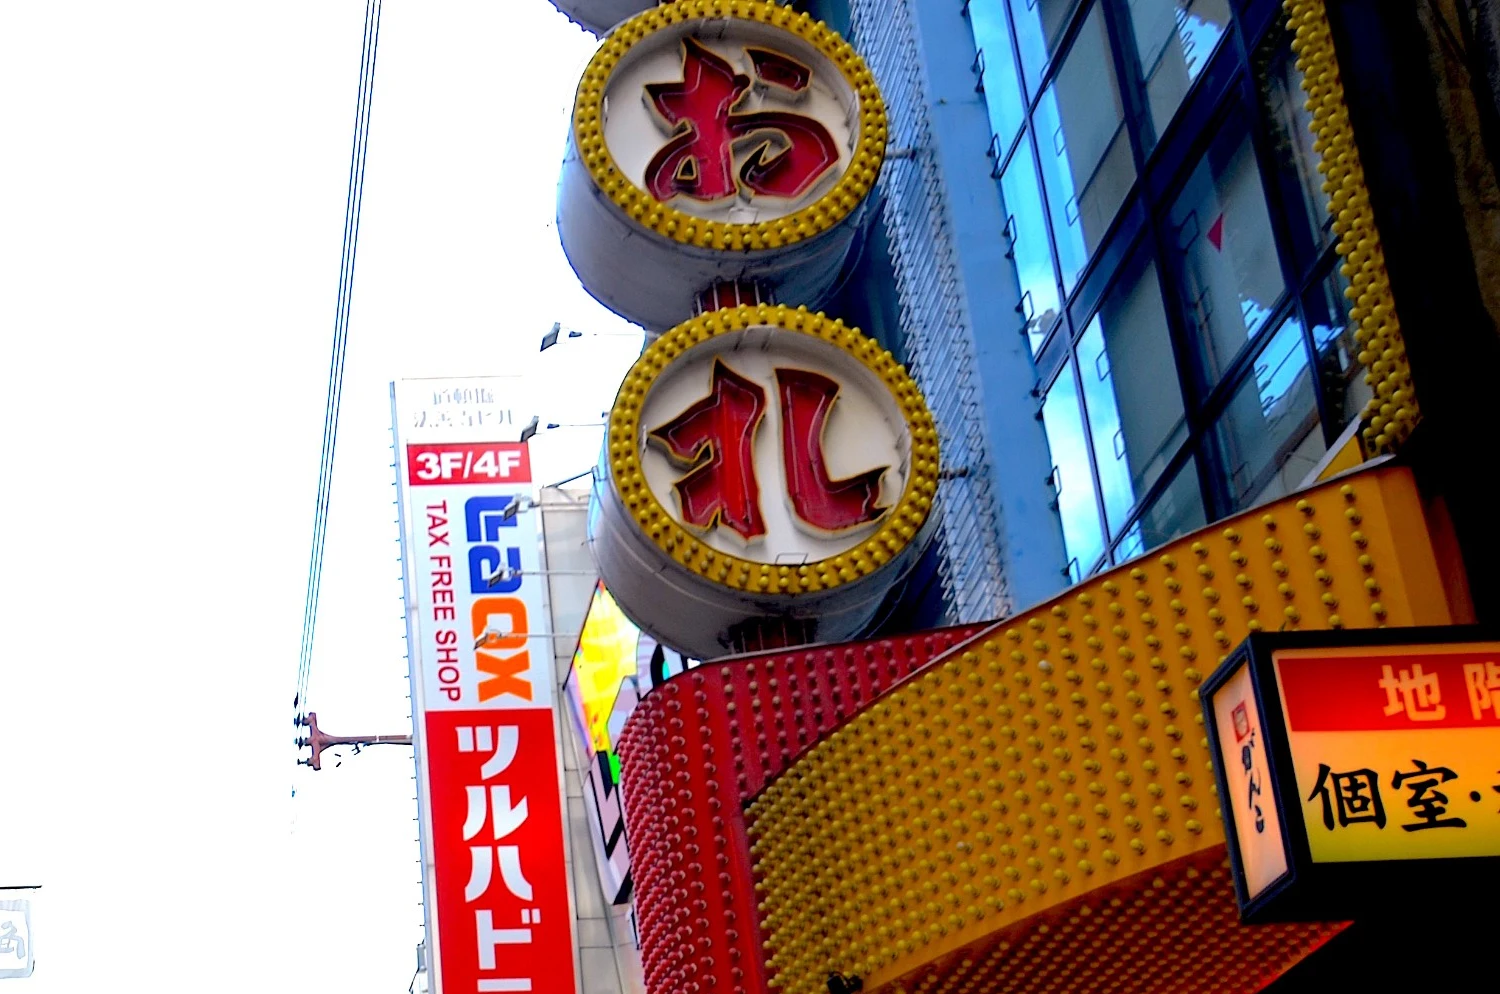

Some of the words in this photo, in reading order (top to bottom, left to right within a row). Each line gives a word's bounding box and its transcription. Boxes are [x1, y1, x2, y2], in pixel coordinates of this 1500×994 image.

[415, 450, 522, 480] 3F/4F
[425, 499, 451, 547] TAX
[429, 557, 456, 622] FREE
[434, 629, 462, 703] SHOP
[1307, 757, 1500, 833] 個室・
